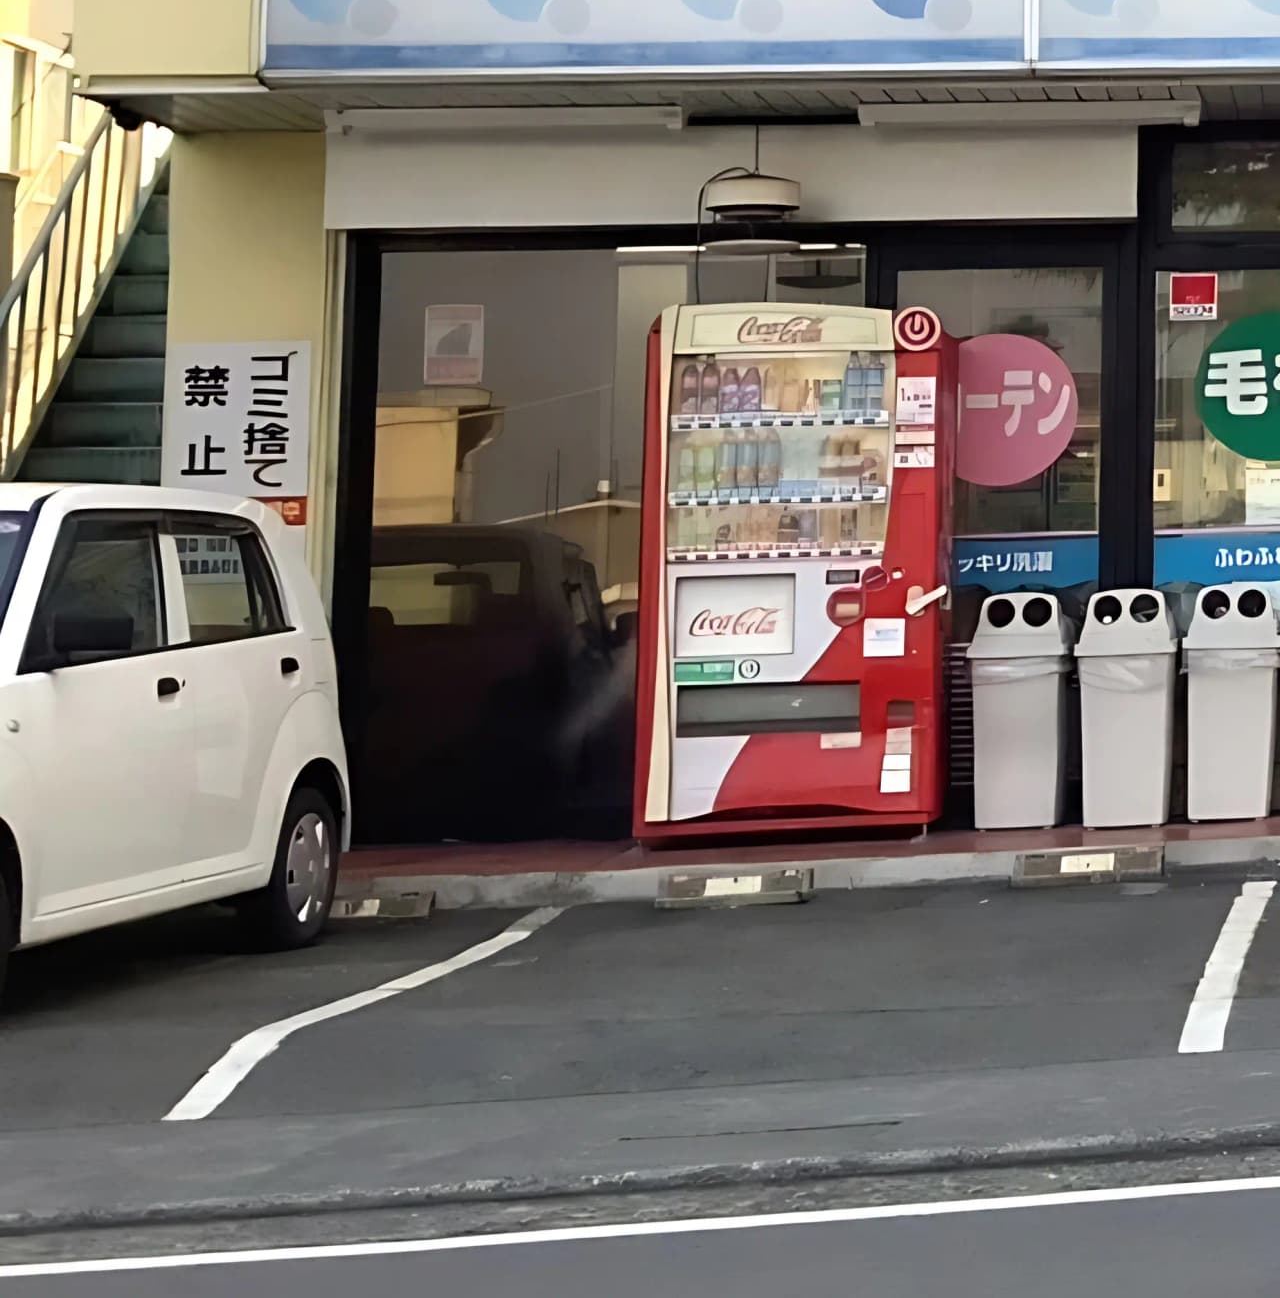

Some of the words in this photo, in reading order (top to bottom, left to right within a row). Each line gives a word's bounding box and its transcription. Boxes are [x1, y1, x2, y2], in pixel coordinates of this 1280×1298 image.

[180, 364, 231, 477] 禁止
[243, 349, 298, 488] ゴミ捨て
[957, 369, 1071, 438] ーテン
